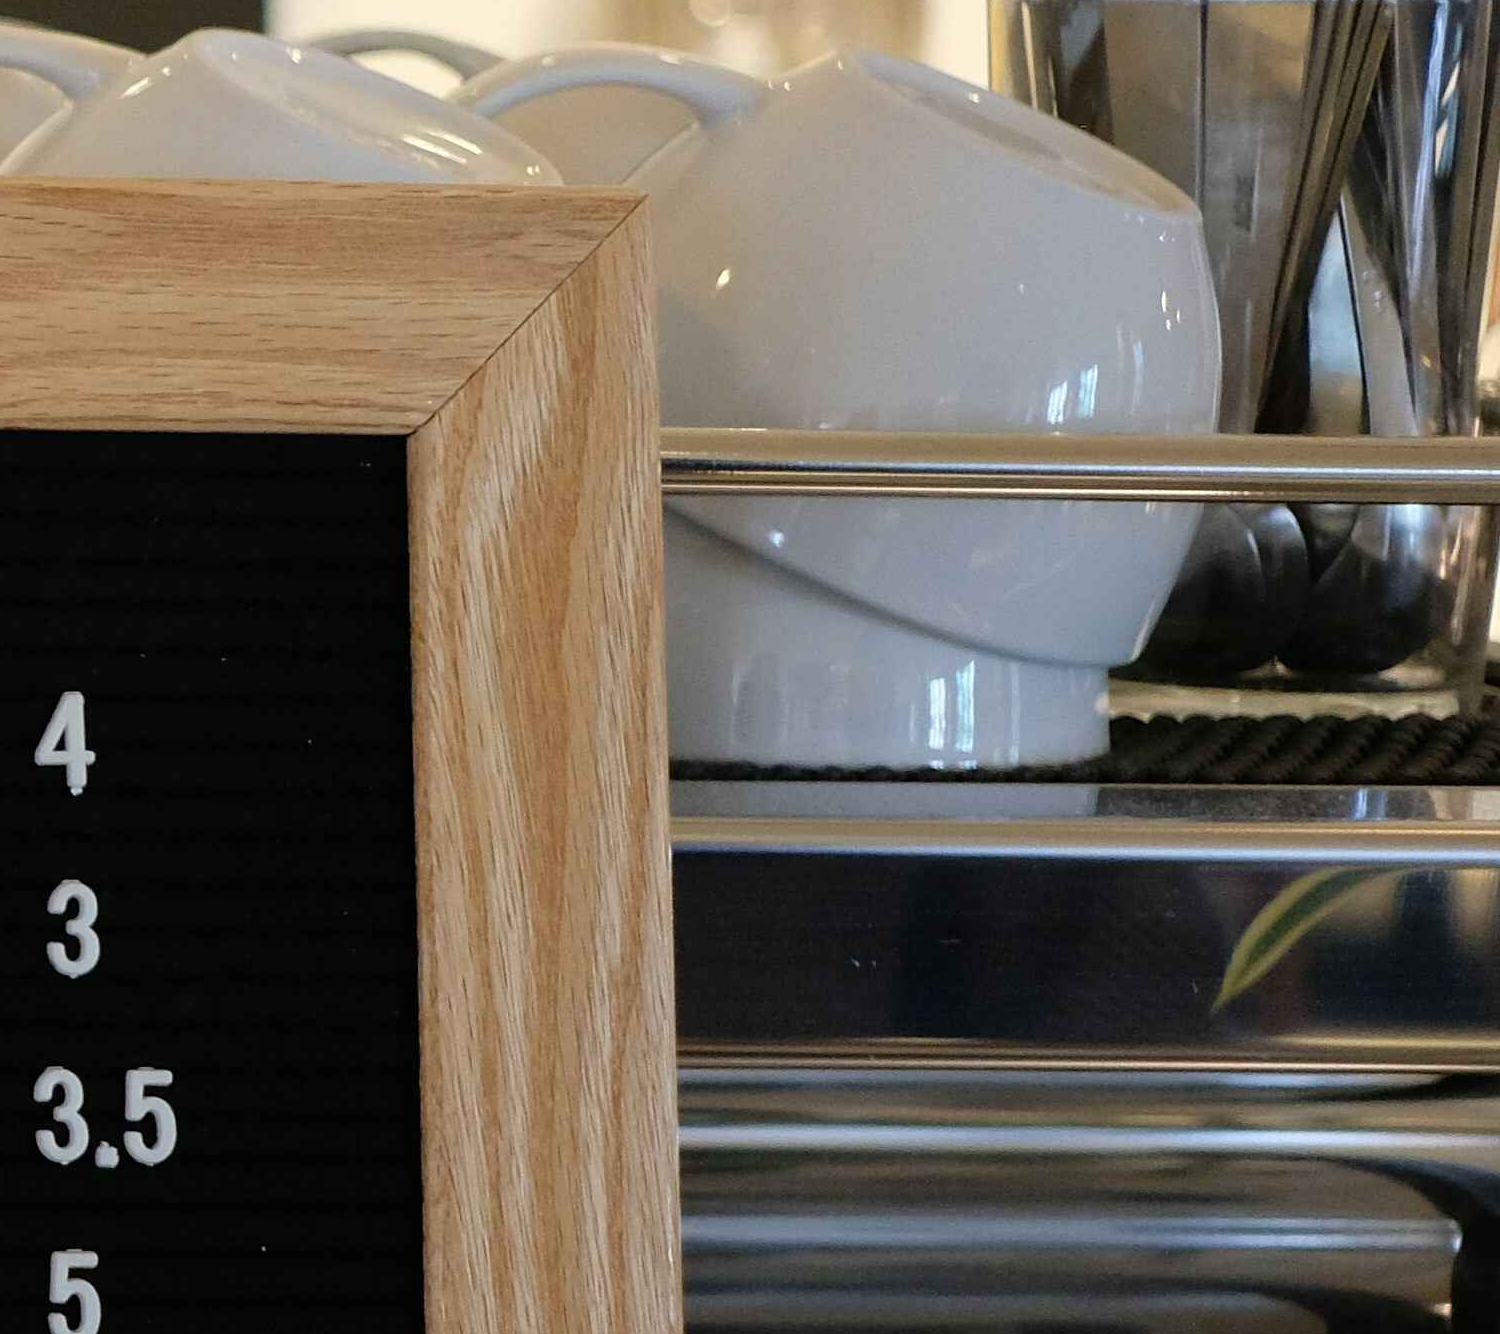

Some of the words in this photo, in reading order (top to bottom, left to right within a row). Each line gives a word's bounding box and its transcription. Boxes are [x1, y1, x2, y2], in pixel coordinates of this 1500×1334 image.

[34, 691, 96, 796] 4
[47, 879, 101, 979] 3
[33, 1066, 177, 1169] 3.5
